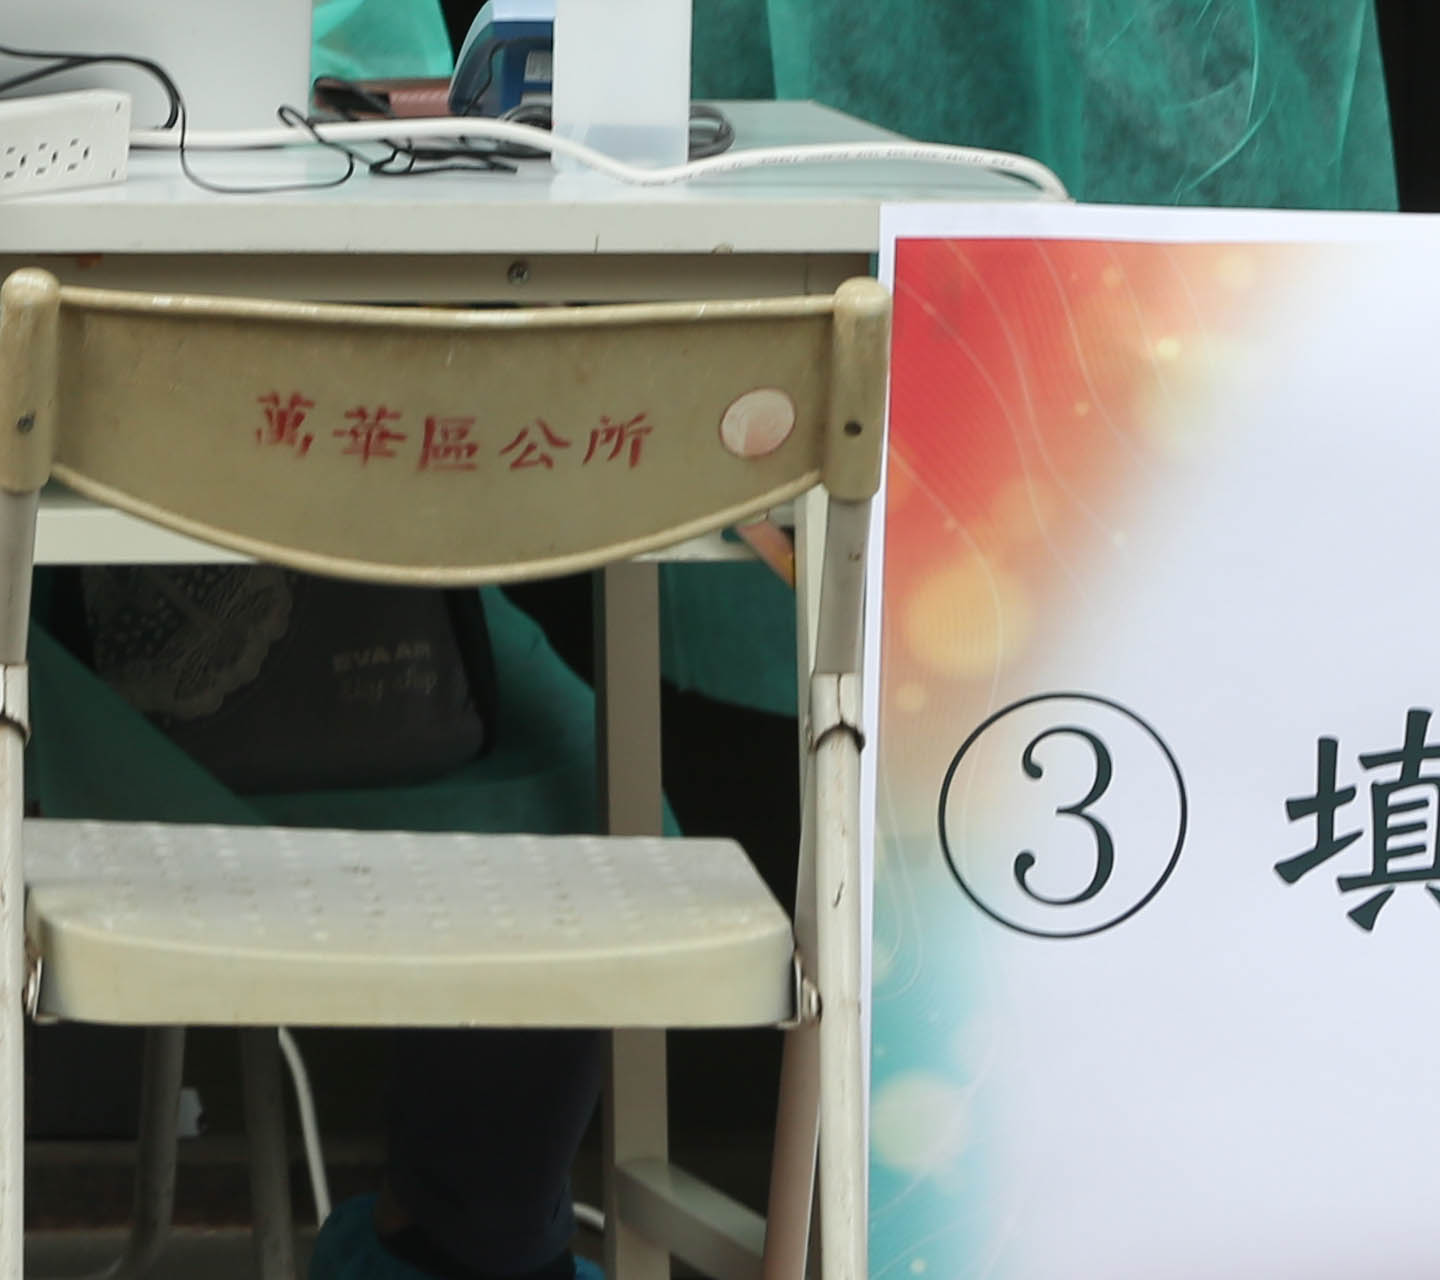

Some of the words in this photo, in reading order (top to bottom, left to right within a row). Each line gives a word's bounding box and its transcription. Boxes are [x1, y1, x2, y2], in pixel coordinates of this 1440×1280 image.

[254, 390, 653, 471] 萬華區公所
